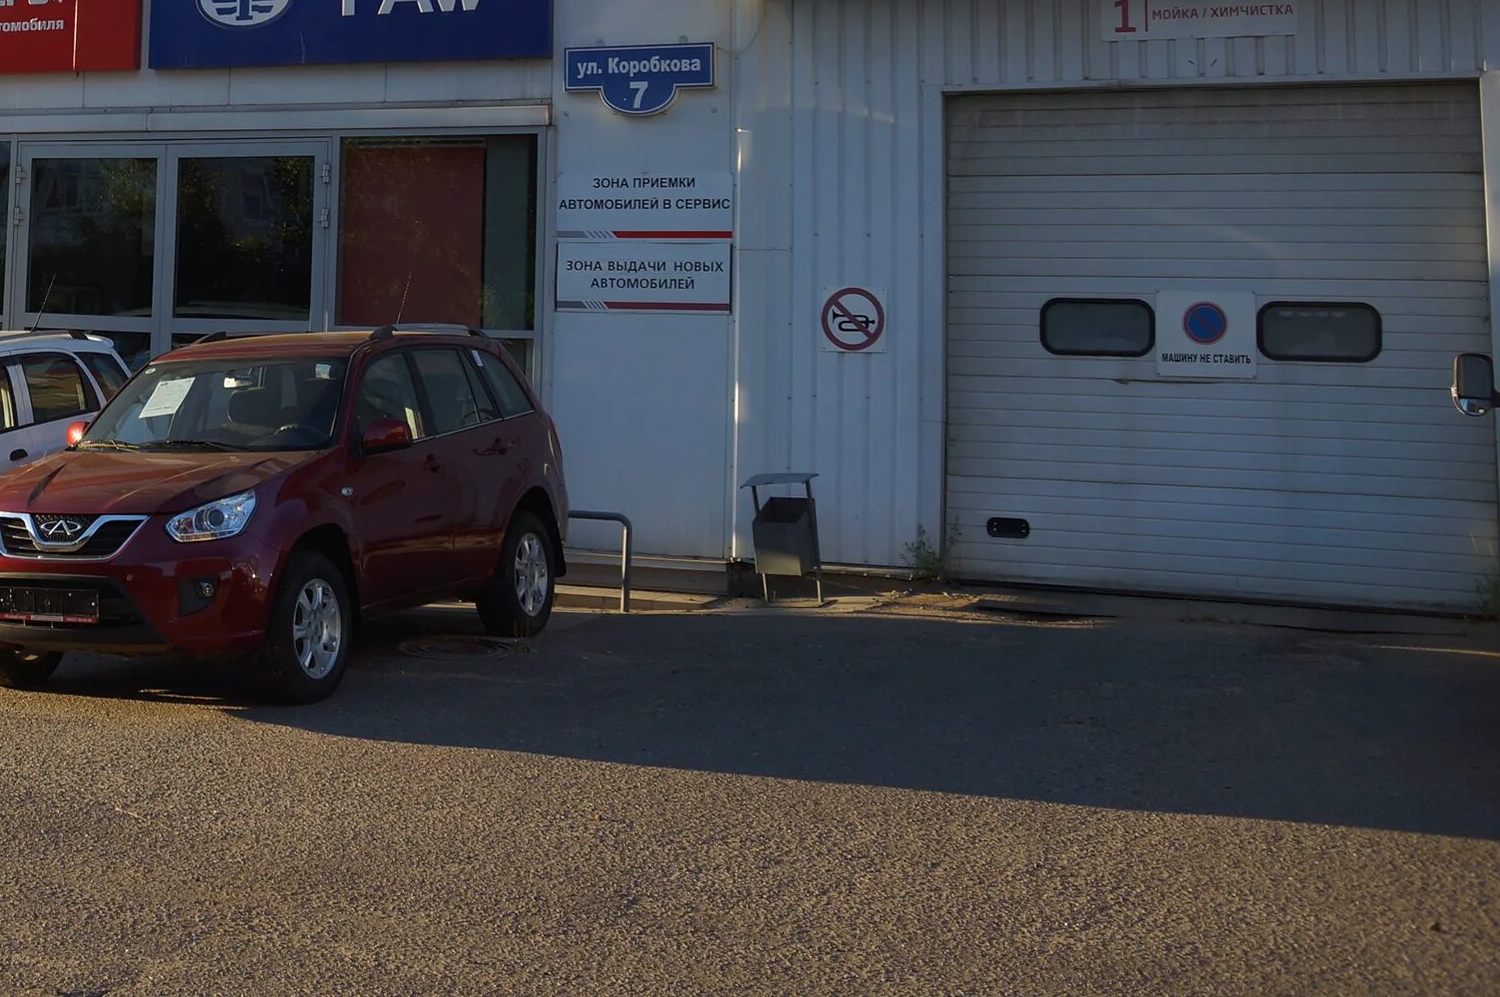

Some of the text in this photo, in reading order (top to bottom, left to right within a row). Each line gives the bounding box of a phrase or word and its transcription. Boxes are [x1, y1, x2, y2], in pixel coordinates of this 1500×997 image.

[1113, 0, 1137, 33] 1
[1151, 7, 1199, 21] МОЙКА
[1210, 3, 1294, 19] ХИМЧИСТКА
[577, 56, 701, 79] ул. Коробкова
[628, 81, 649, 109] 7
[592, 177, 696, 189] ЗОНА ПРИЕМКИ
[559, 196, 731, 210] АВТОМОБИЛЕЙ В СЕРВИС
[566, 260, 724, 273] ЗОНА ВЫДАЧИ НОВЫХ
[590, 276, 695, 289] АВТОМОБИЛЕЙ
[1161, 353, 1252, 364] МАШИНУ НЕ СТАВИТЬ
